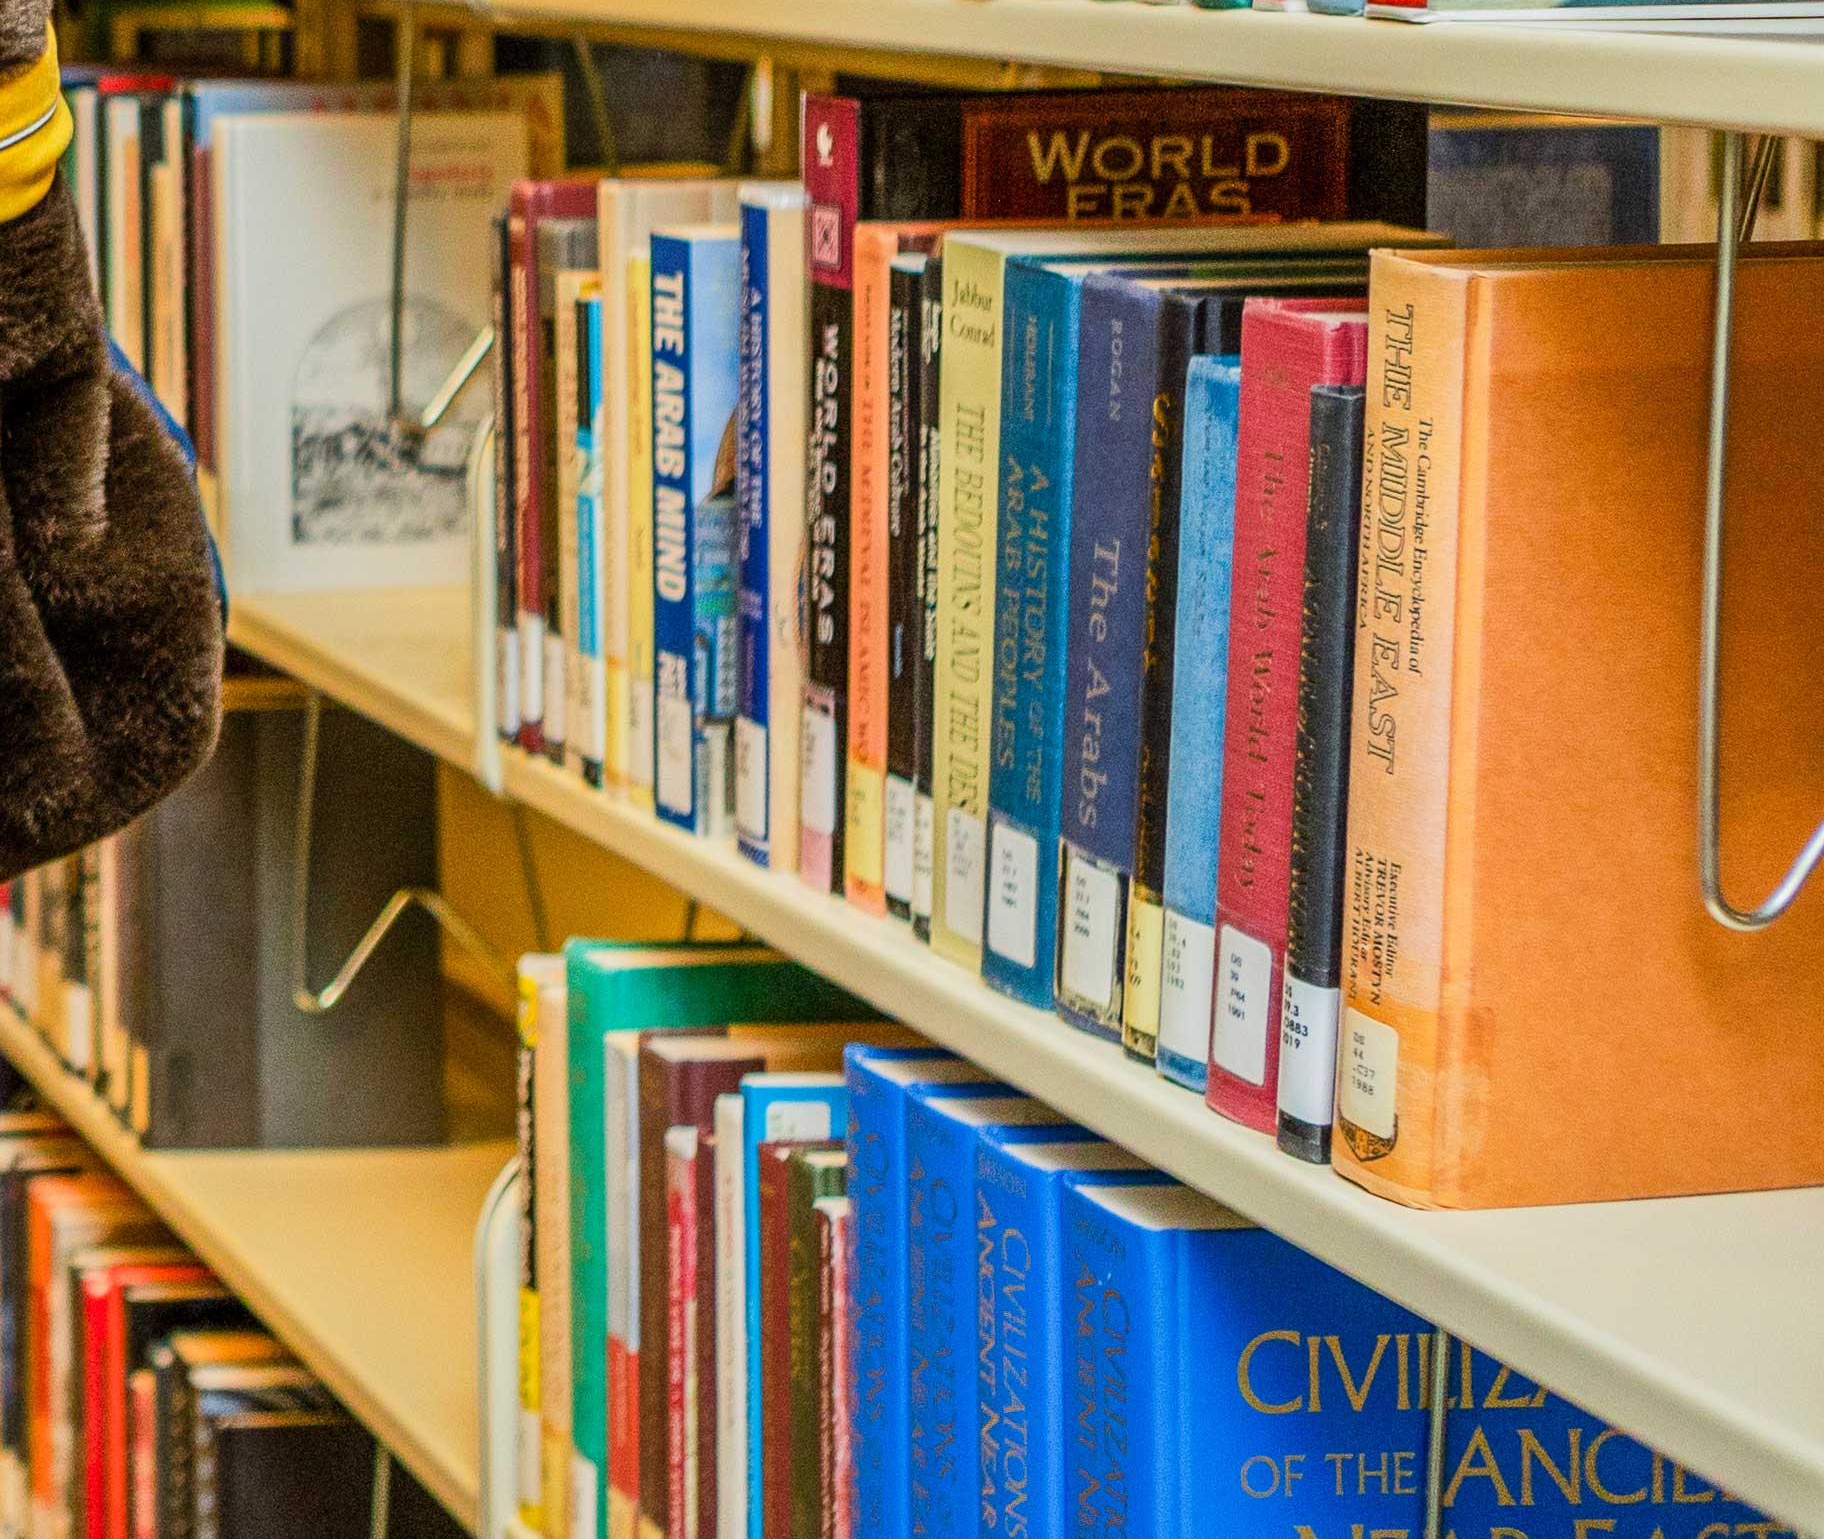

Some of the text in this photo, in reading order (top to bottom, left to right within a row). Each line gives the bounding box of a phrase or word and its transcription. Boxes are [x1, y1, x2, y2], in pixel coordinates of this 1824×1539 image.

[1025, 132, 1292, 186] WORLD
[1067, 181, 1253, 221] ERAS
[950, 313, 996, 350] Conrad
[1109, 318, 1124, 422] ROGAN
[653, 269, 688, 603] THE ARAB MIND
[816, 323, 840, 646] WORLD ERAS
[1029, 465, 1051, 489] A
[1258, 450, 1286, 531] The
[1365, 427, 1376, 477] AND
[1022, 499, 1050, 693] HISTORY
[1358, 556, 1371, 629] AFRICA
[1366, 303, 1415, 777] THE MIDDLE EAST
[1406, 416, 1434, 677] The Cambridge Encyclopedia of
[993, 456, 1027, 770] ARAB PEOPLES
[1077, 538, 1122, 831] The Arabs
[1353, 846, 1365, 917] ALBERT
[1369, 857, 1388, 1006] TREVOR MOSTYN
[1385, 861, 1402, 980] Executive Editor
[976, 1189, 1000, 1531] ANCIENT NEAR
[1000, 1226, 1033, 1539] CIVILIZATIONS
[1241, 1453, 1306, 1500] OF
[1324, 1450, 1418, 1497] THE
